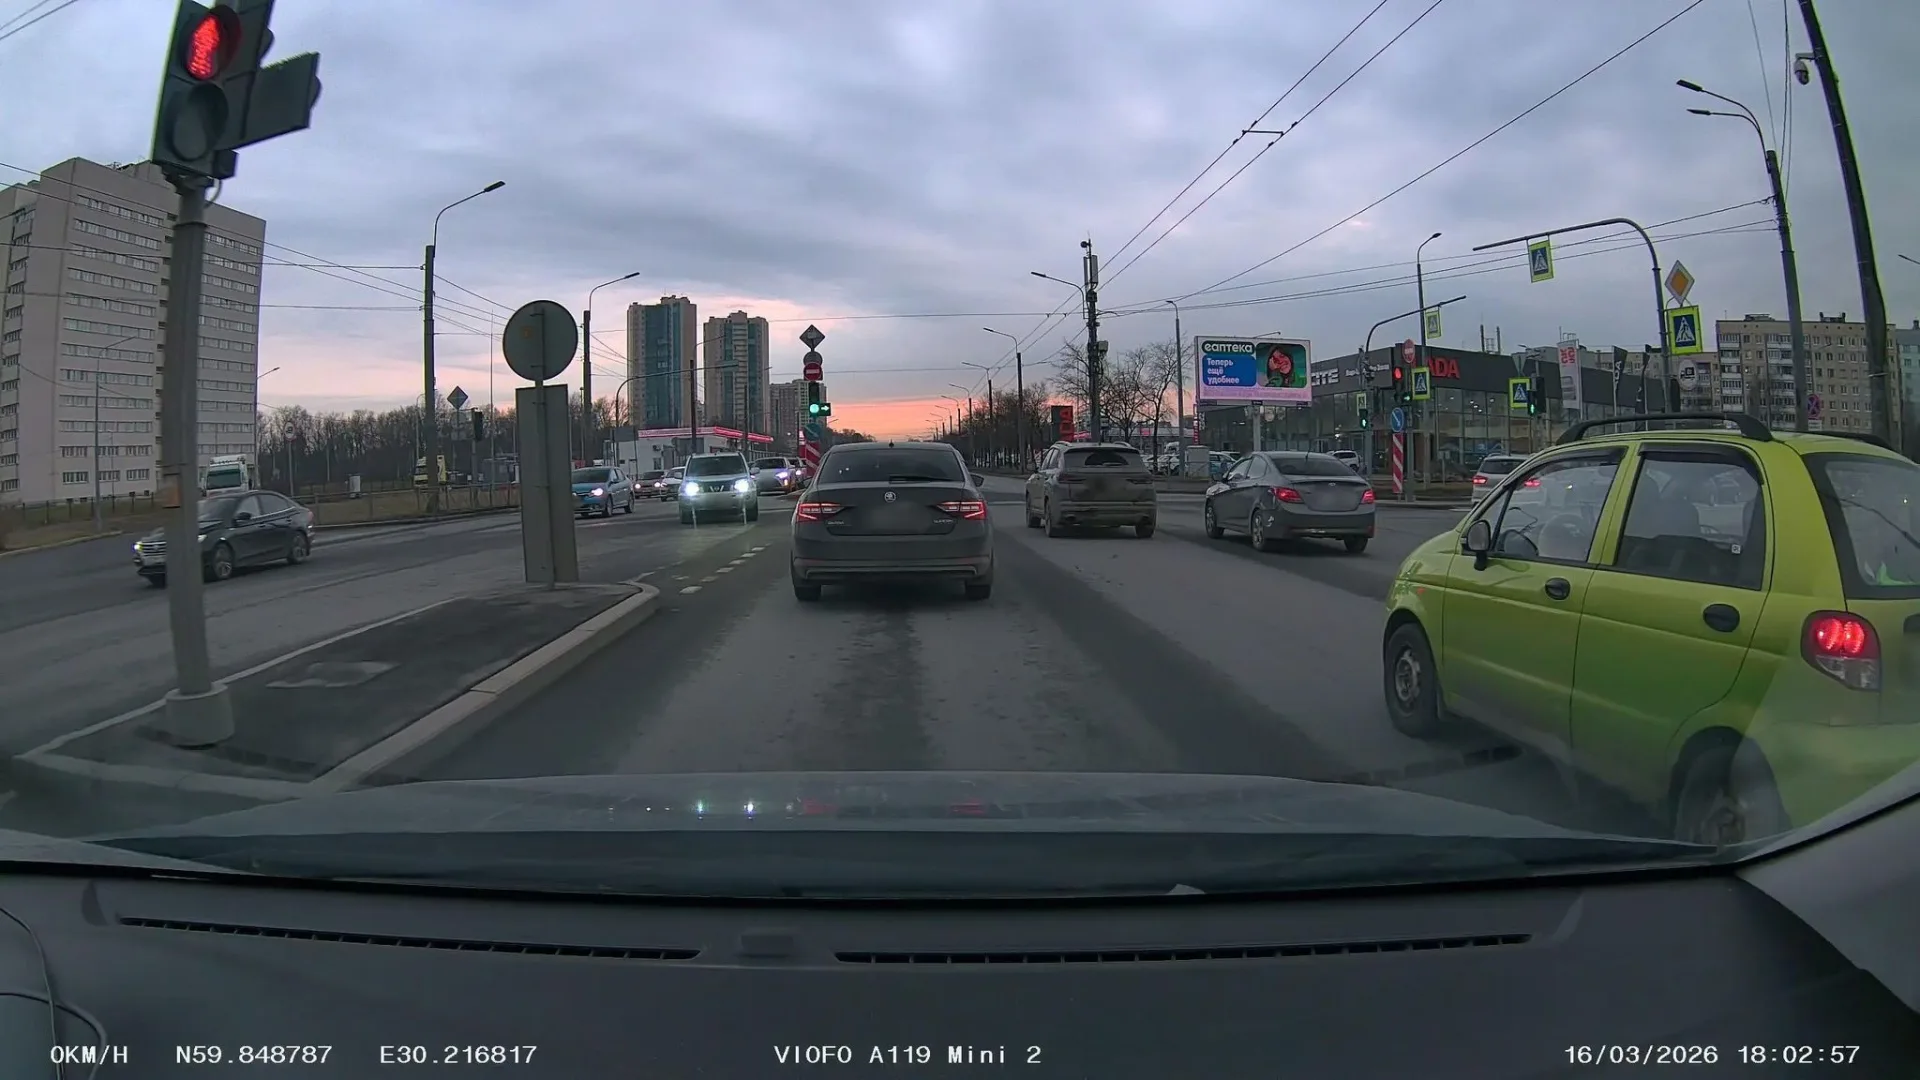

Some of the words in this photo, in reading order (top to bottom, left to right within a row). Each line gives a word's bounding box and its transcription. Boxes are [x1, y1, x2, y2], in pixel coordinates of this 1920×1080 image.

[1204, 343, 1253, 353] еаптека
[1207, 358, 1234, 367] Теперь
[1207, 367, 1224, 375] ещё
[1207, 375, 1240, 385] удобнее
